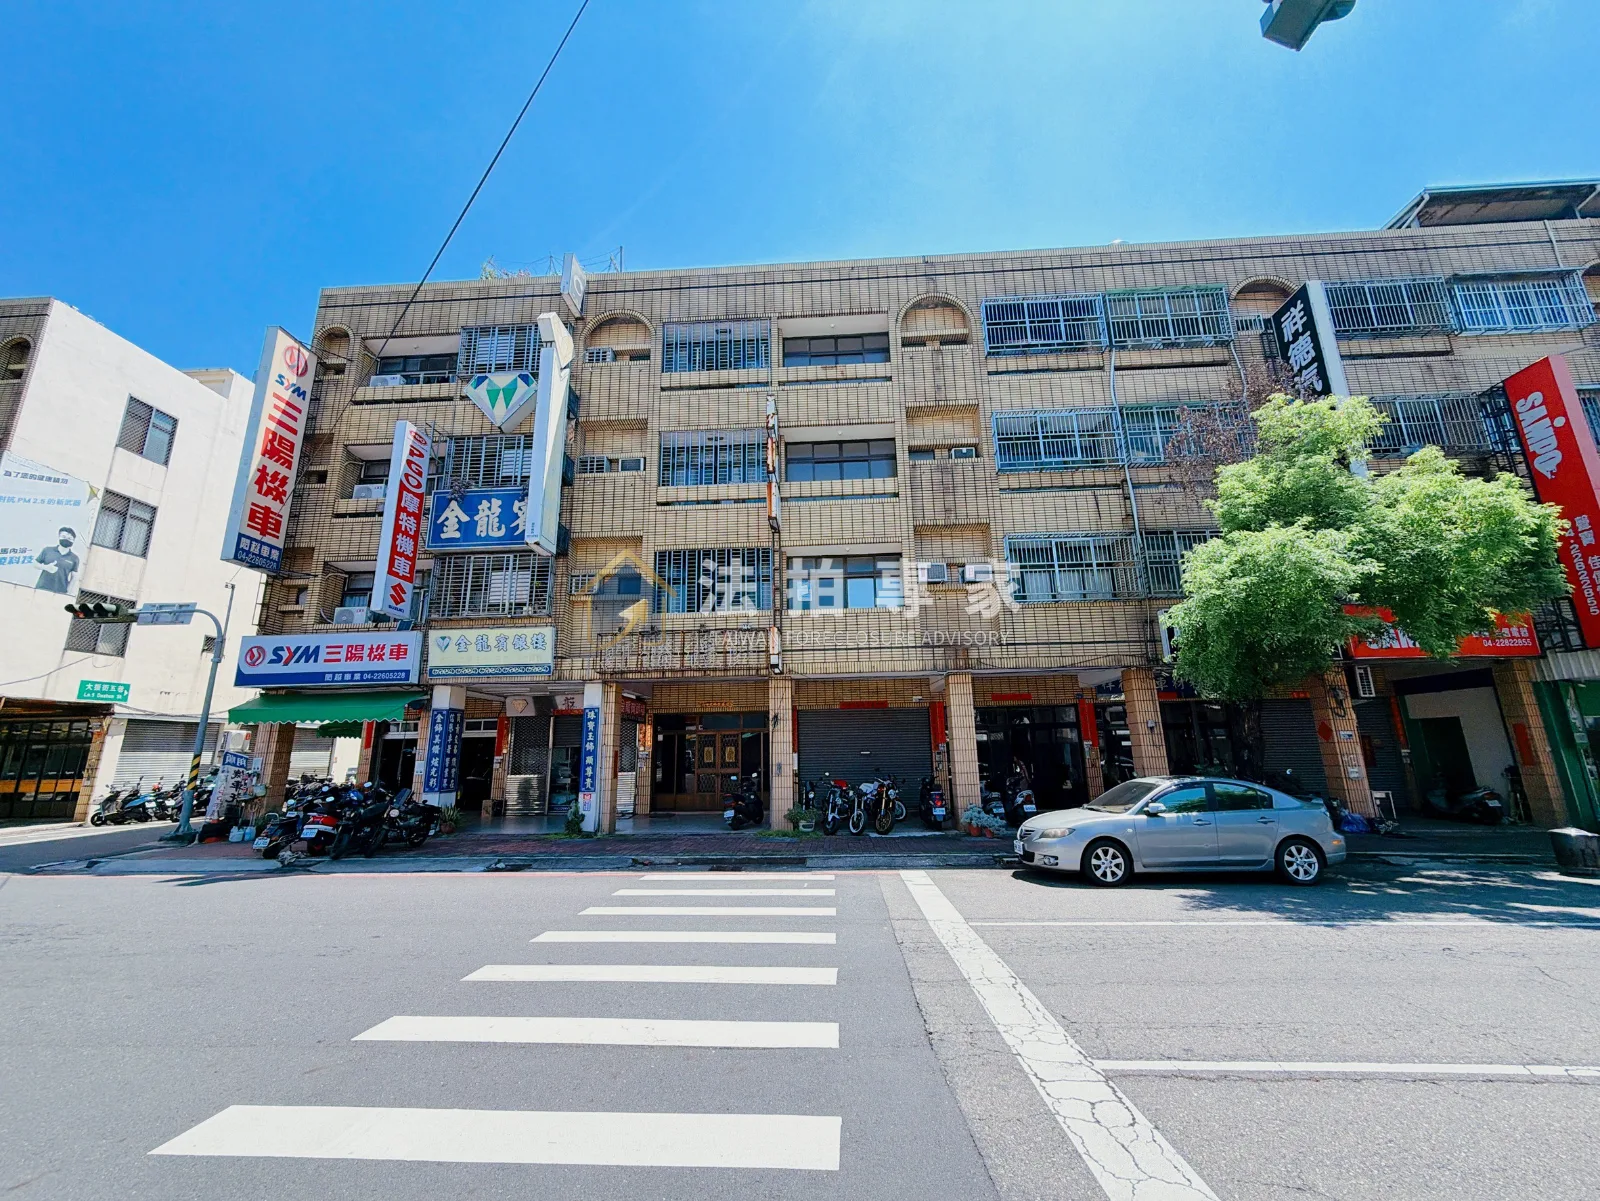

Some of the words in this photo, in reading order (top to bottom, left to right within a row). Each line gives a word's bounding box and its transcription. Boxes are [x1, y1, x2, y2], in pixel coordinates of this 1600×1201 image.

[275, 373, 307, 401] SYM
[1515, 391, 1563, 479] SAMPO
[247, 391, 303, 540] 三陽機車
[17, 496, 31, 504] PM
[392, 490, 420, 577] 摩特機車
[388, 604, 405, 614] SUZUKI
[454, 631, 548, 653] 金龍賓銀樓
[267, 644, 321, 667] SYM
[323, 643, 409, 663] 三陽機車
[362, 672, 406, 681] 04-22605228
